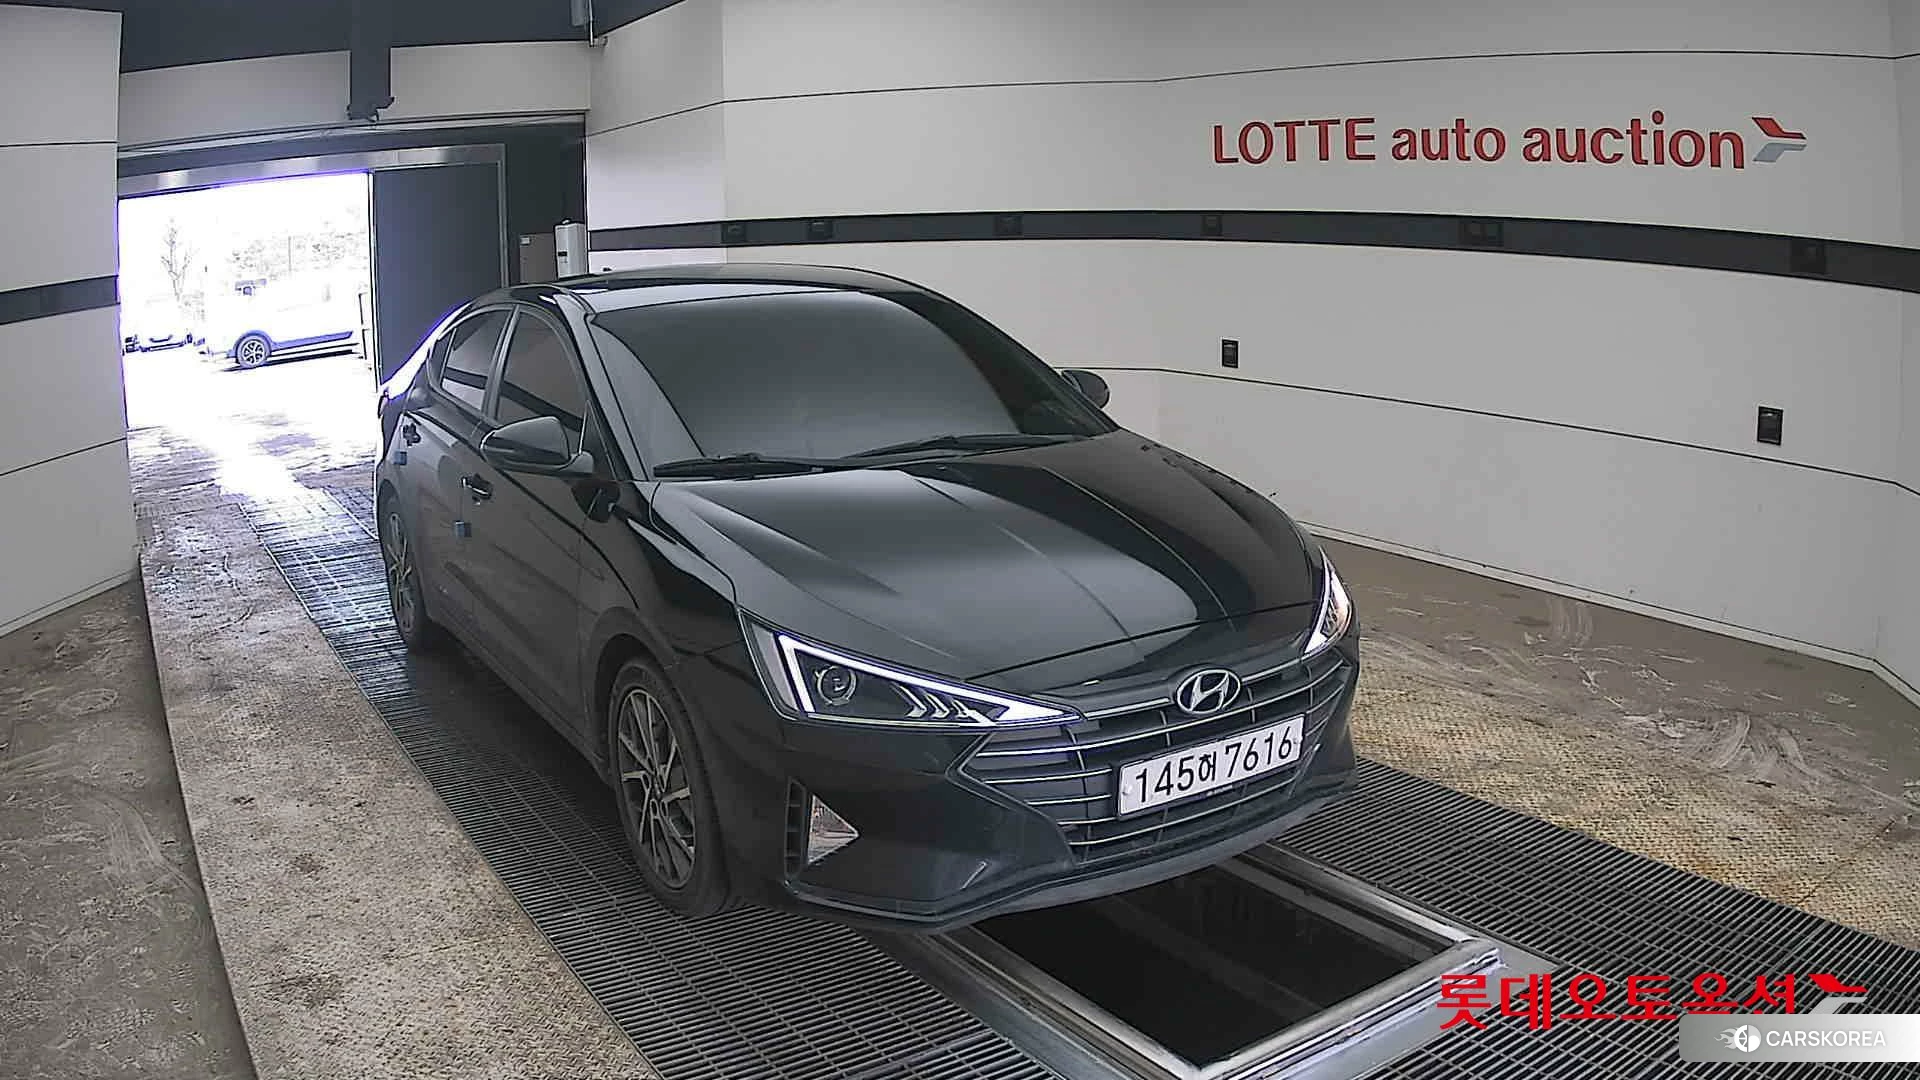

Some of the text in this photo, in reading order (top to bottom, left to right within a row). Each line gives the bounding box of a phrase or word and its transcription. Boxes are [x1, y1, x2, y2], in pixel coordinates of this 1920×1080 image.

[1213, 110, 1746, 169] LOTTE auto auction
[1135, 726, 1292, 803] 145허 7616
